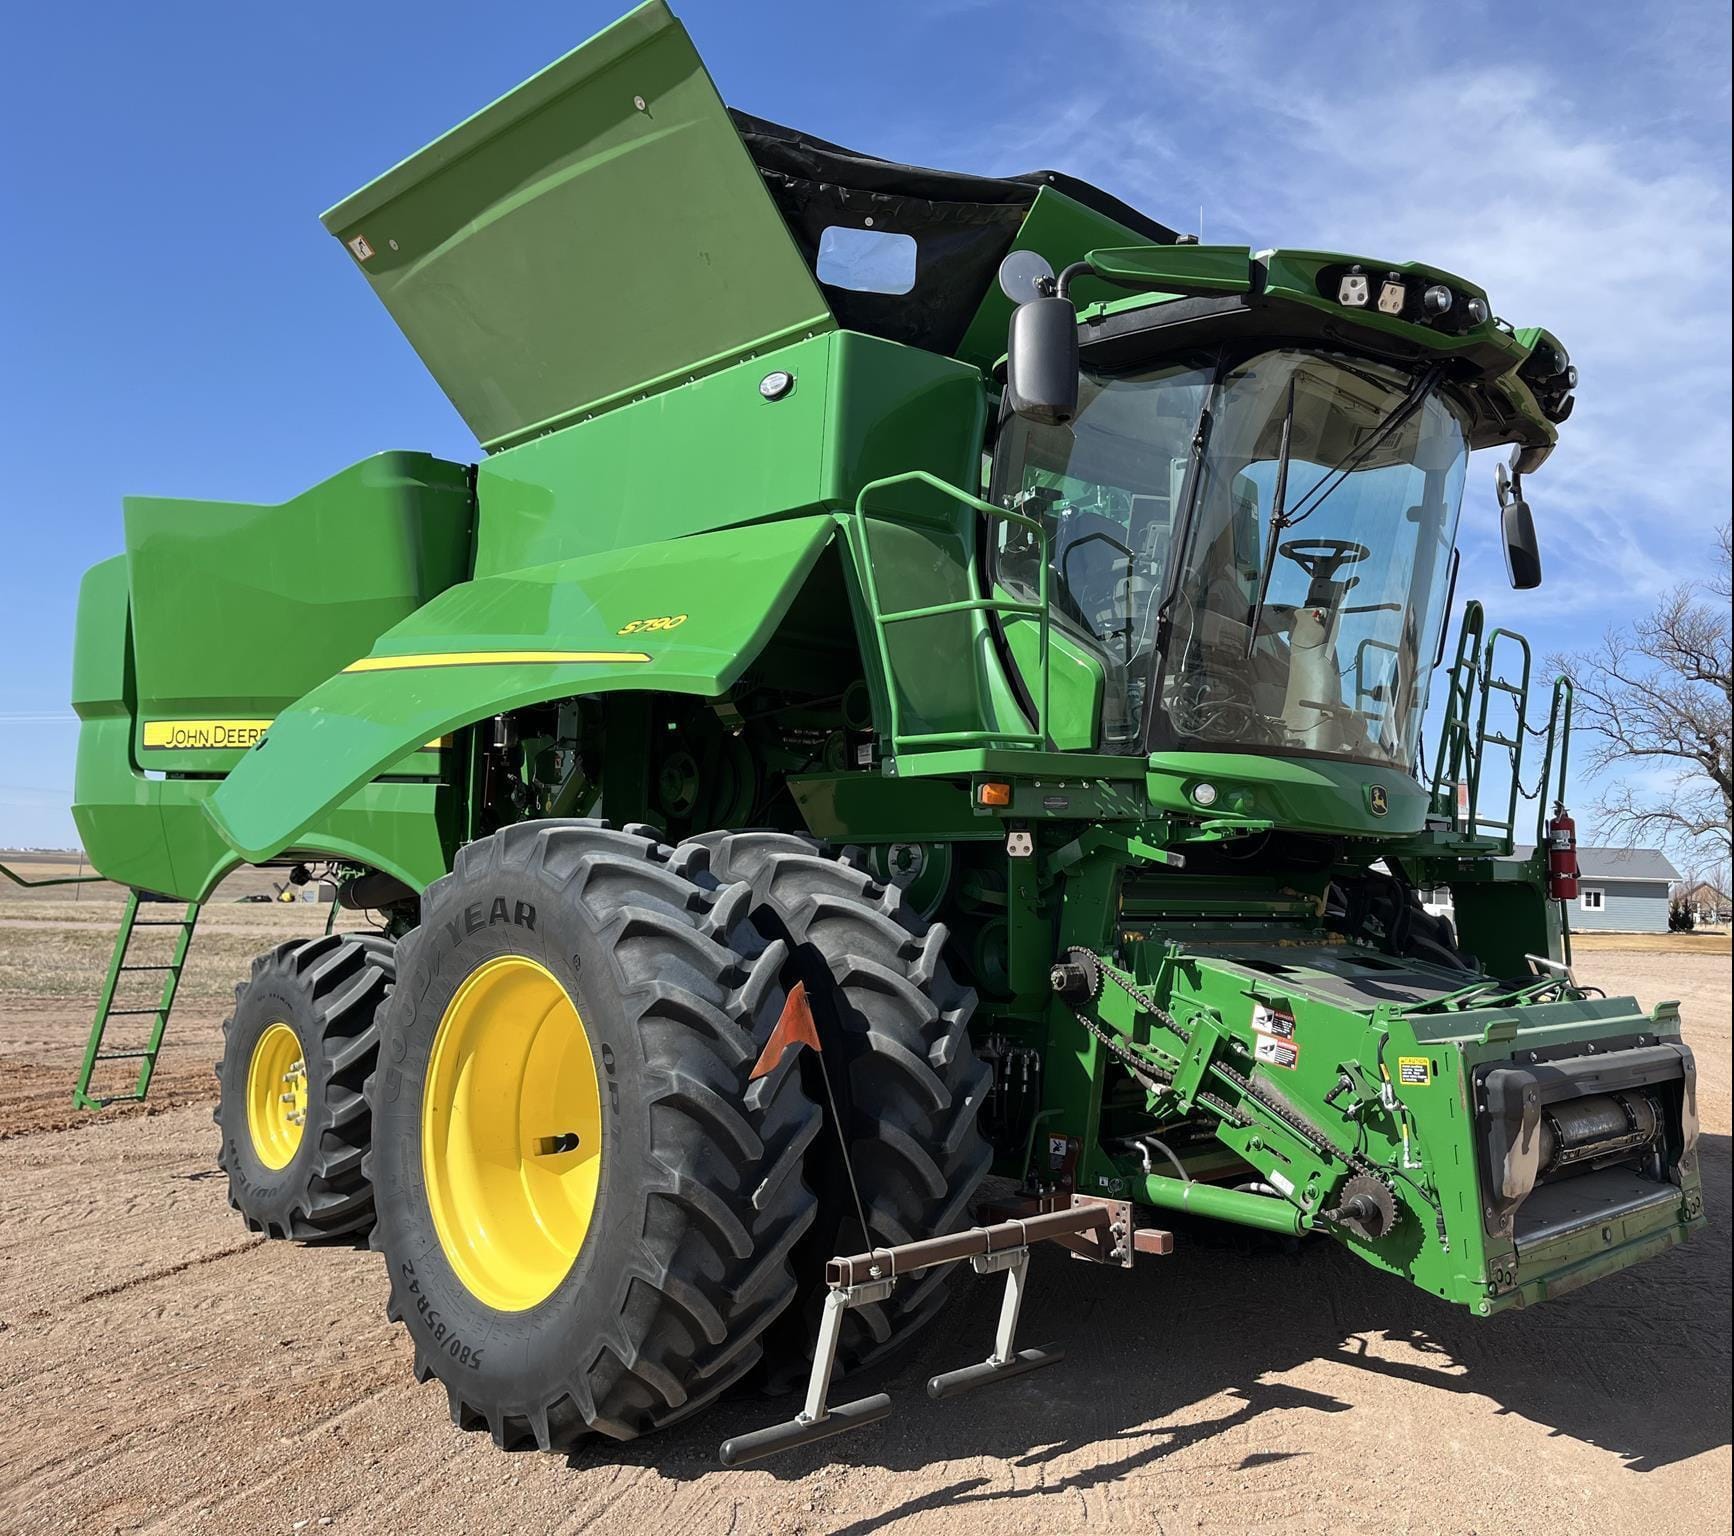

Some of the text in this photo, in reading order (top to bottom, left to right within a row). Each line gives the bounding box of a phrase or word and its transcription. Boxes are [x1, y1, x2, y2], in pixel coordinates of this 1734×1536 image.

[616, 613, 688, 635] S790
[166, 726, 209, 745] JOHN
[402, 1259, 485, 1370] 580/85R42
